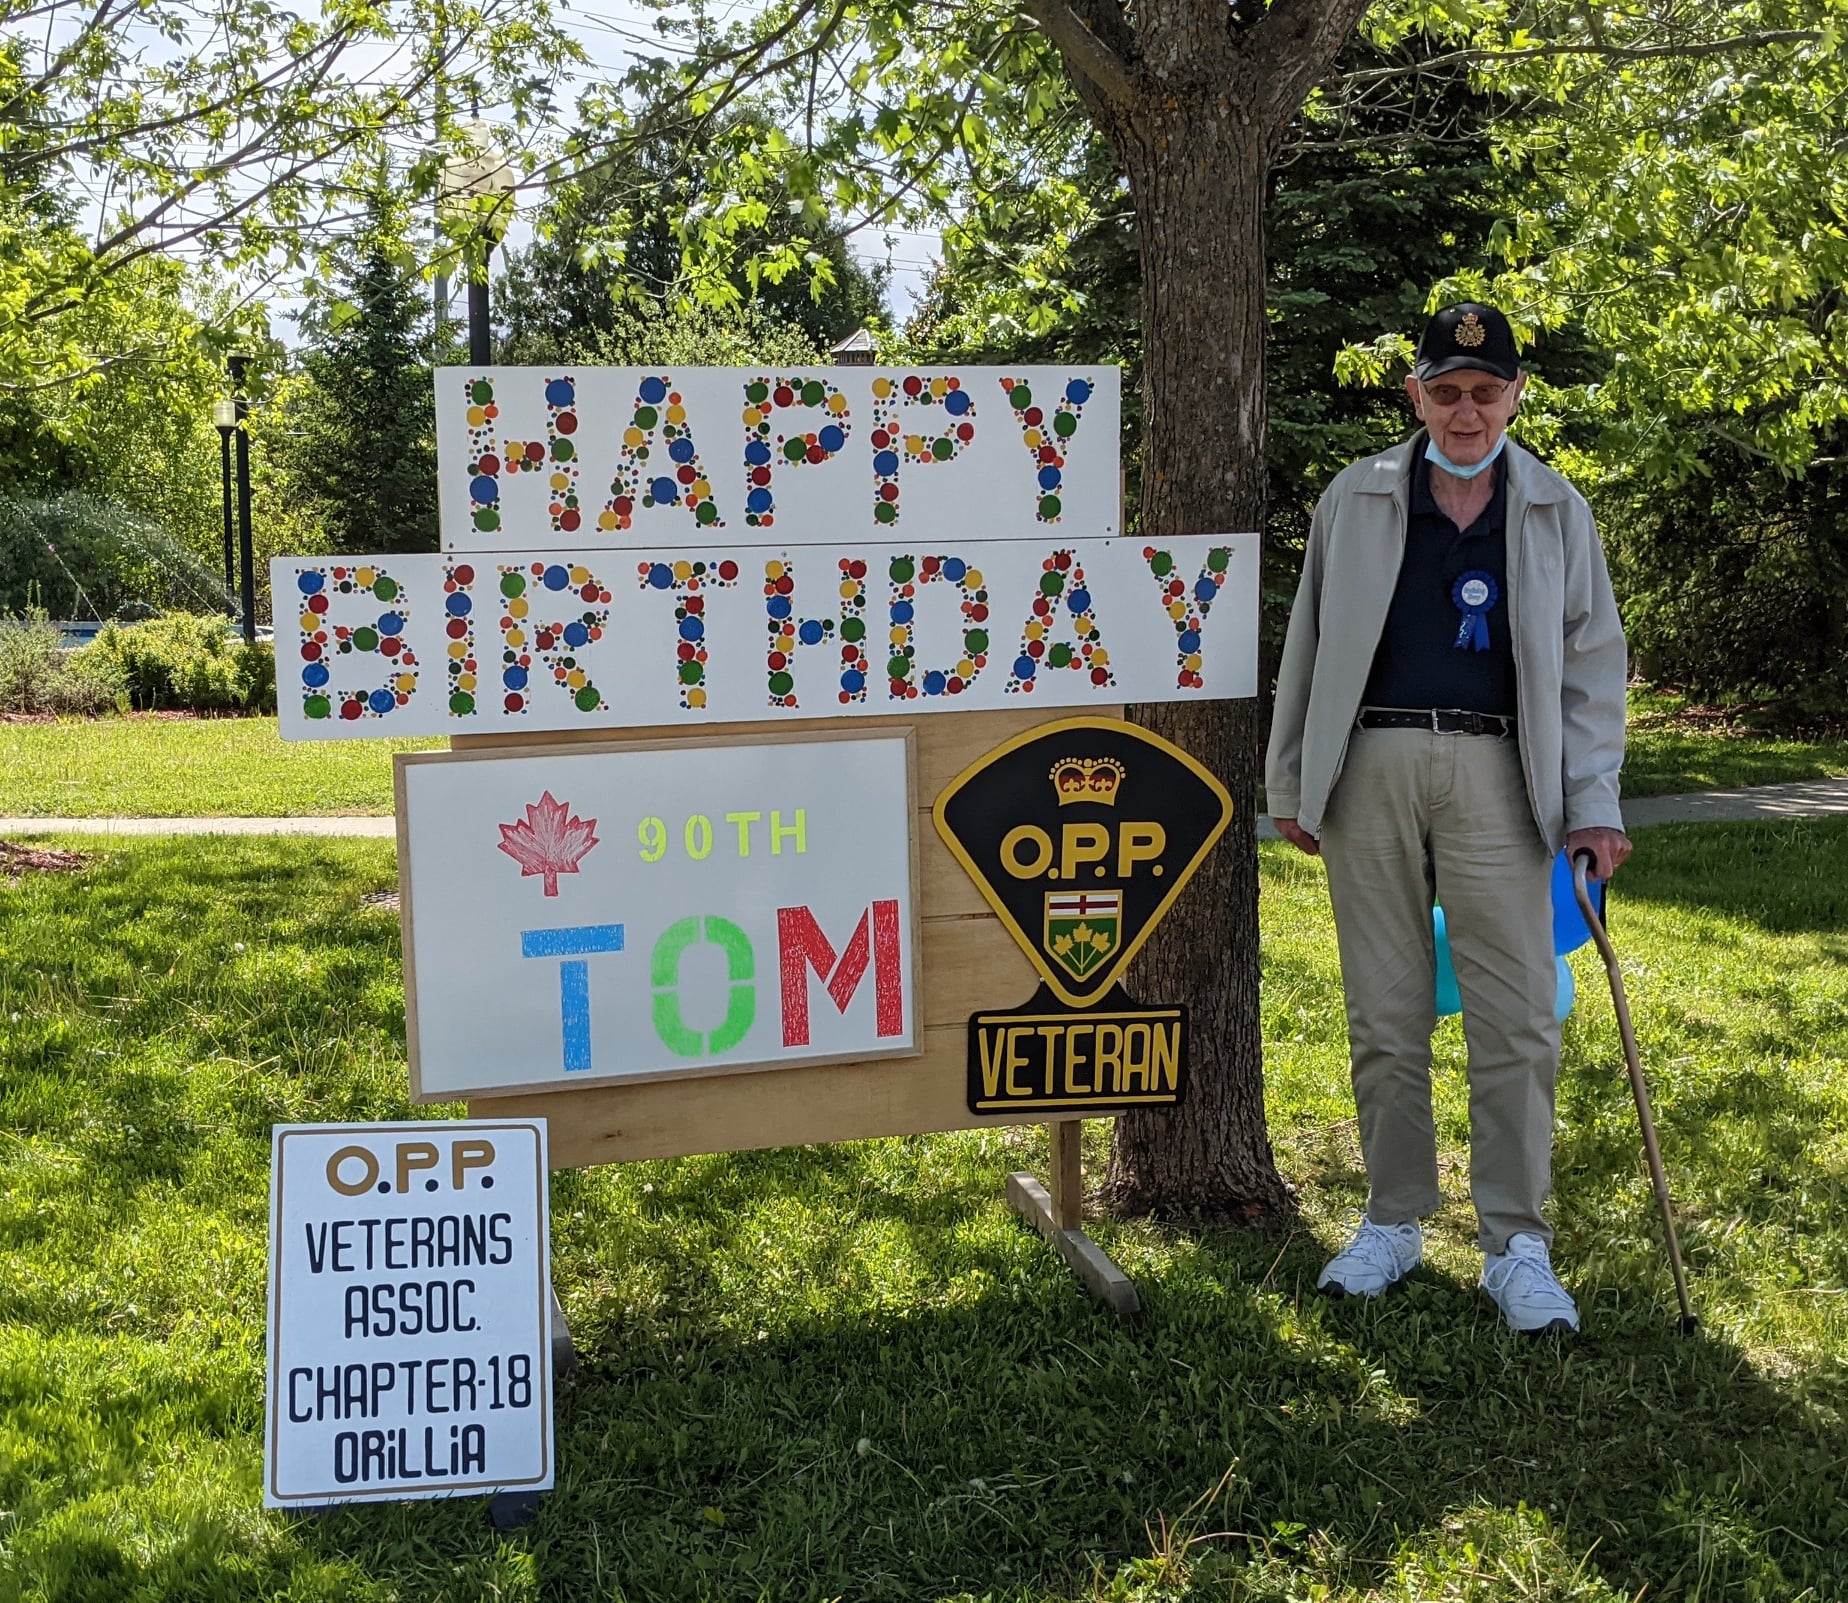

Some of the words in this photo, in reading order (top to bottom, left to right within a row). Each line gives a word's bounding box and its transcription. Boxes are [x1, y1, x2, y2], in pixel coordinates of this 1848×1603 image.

[464, 375, 1095, 533] HAPPY
[294, 544, 1229, 721] BIRTHDAY
[637, 808, 807, 863] 90TH
[1000, 821, 1167, 880] O.P.P.
[520, 899, 905, 1072] TOM
[978, 1021, 1182, 1097] VETERAN
[325, 1139, 497, 1197] O.P.P.
[305, 1212, 513, 1274] VETERANS
[344, 1279, 482, 1339] ASSOC.
[288, 1354, 532, 1423] CHAPTER-18
